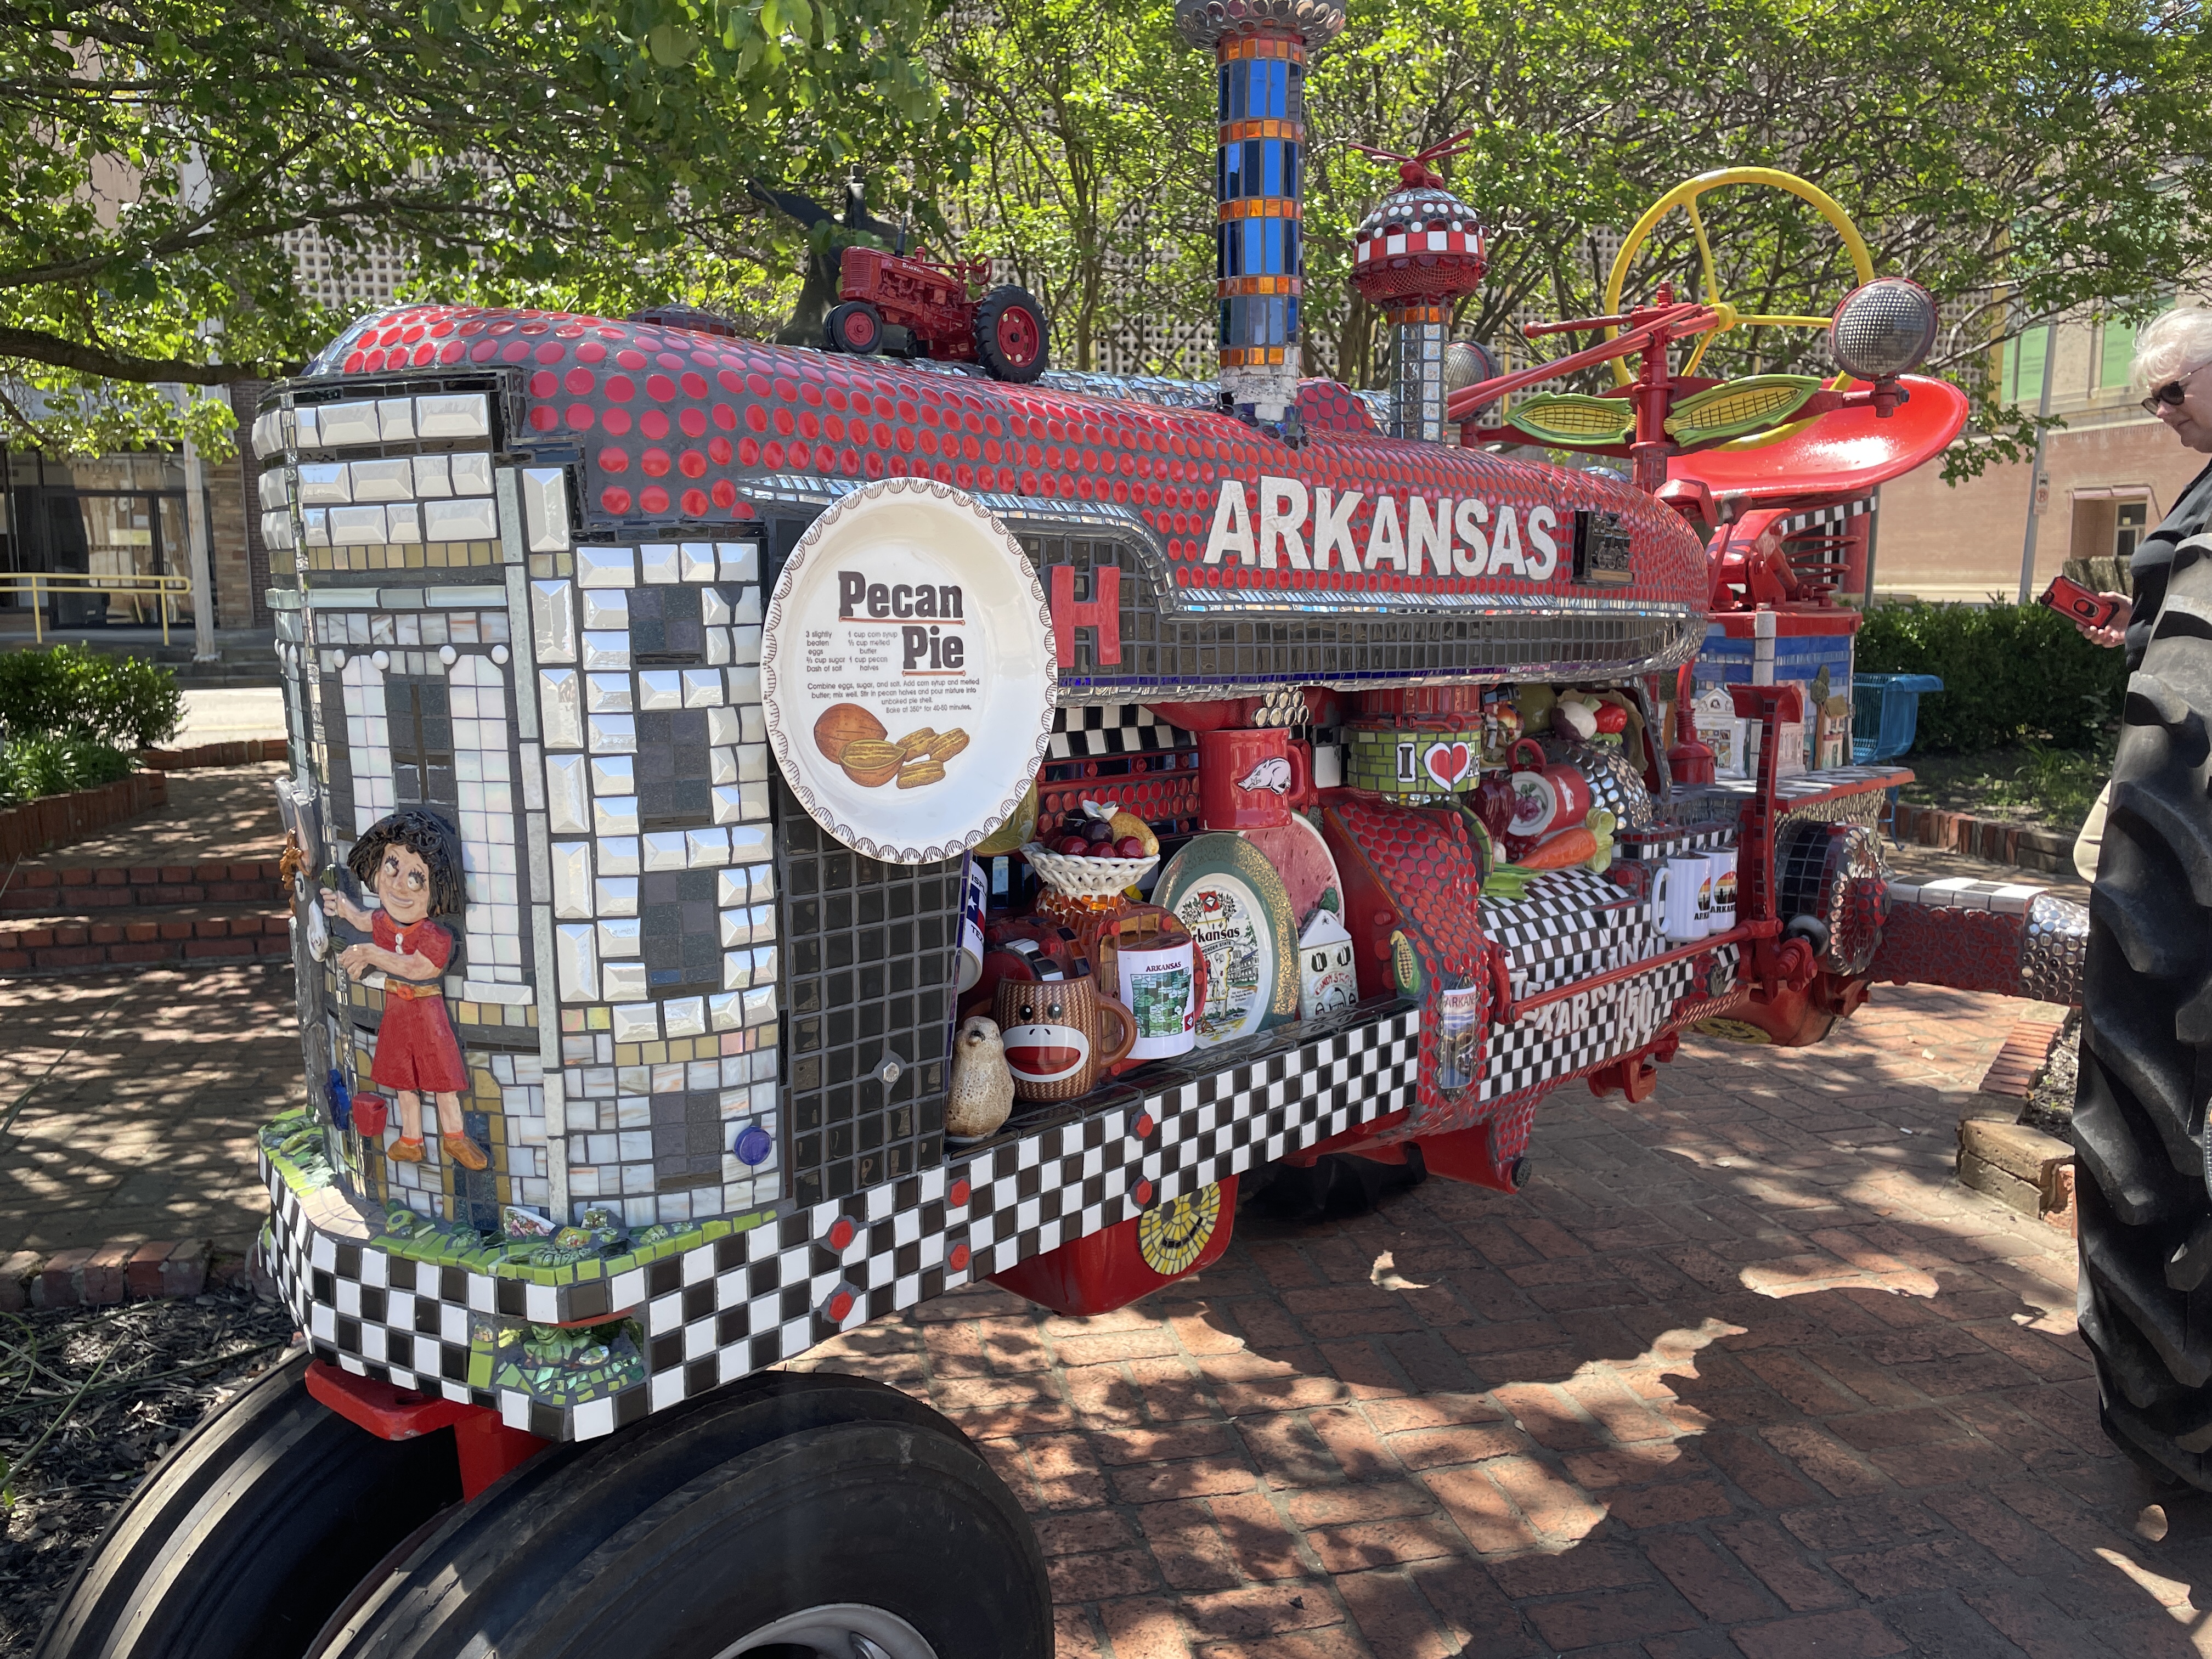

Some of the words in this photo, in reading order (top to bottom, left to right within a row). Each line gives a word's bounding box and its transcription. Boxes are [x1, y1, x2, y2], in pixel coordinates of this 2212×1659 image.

[1203, 475, 1557, 580] ARKANSAS
[838, 571, 963, 618] Pecan
[812, 630, 832, 639] slightly
[1052, 566, 1121, 668] H
[815, 657, 826, 665] cup
[902, 625, 964, 669] Pie
[1398, 746, 1414, 779] I
[1192, 927, 1240, 943] rkansas
[1146, 961, 1181, 972] ARKANSAS
[1616, 984, 1653, 1041] 150
